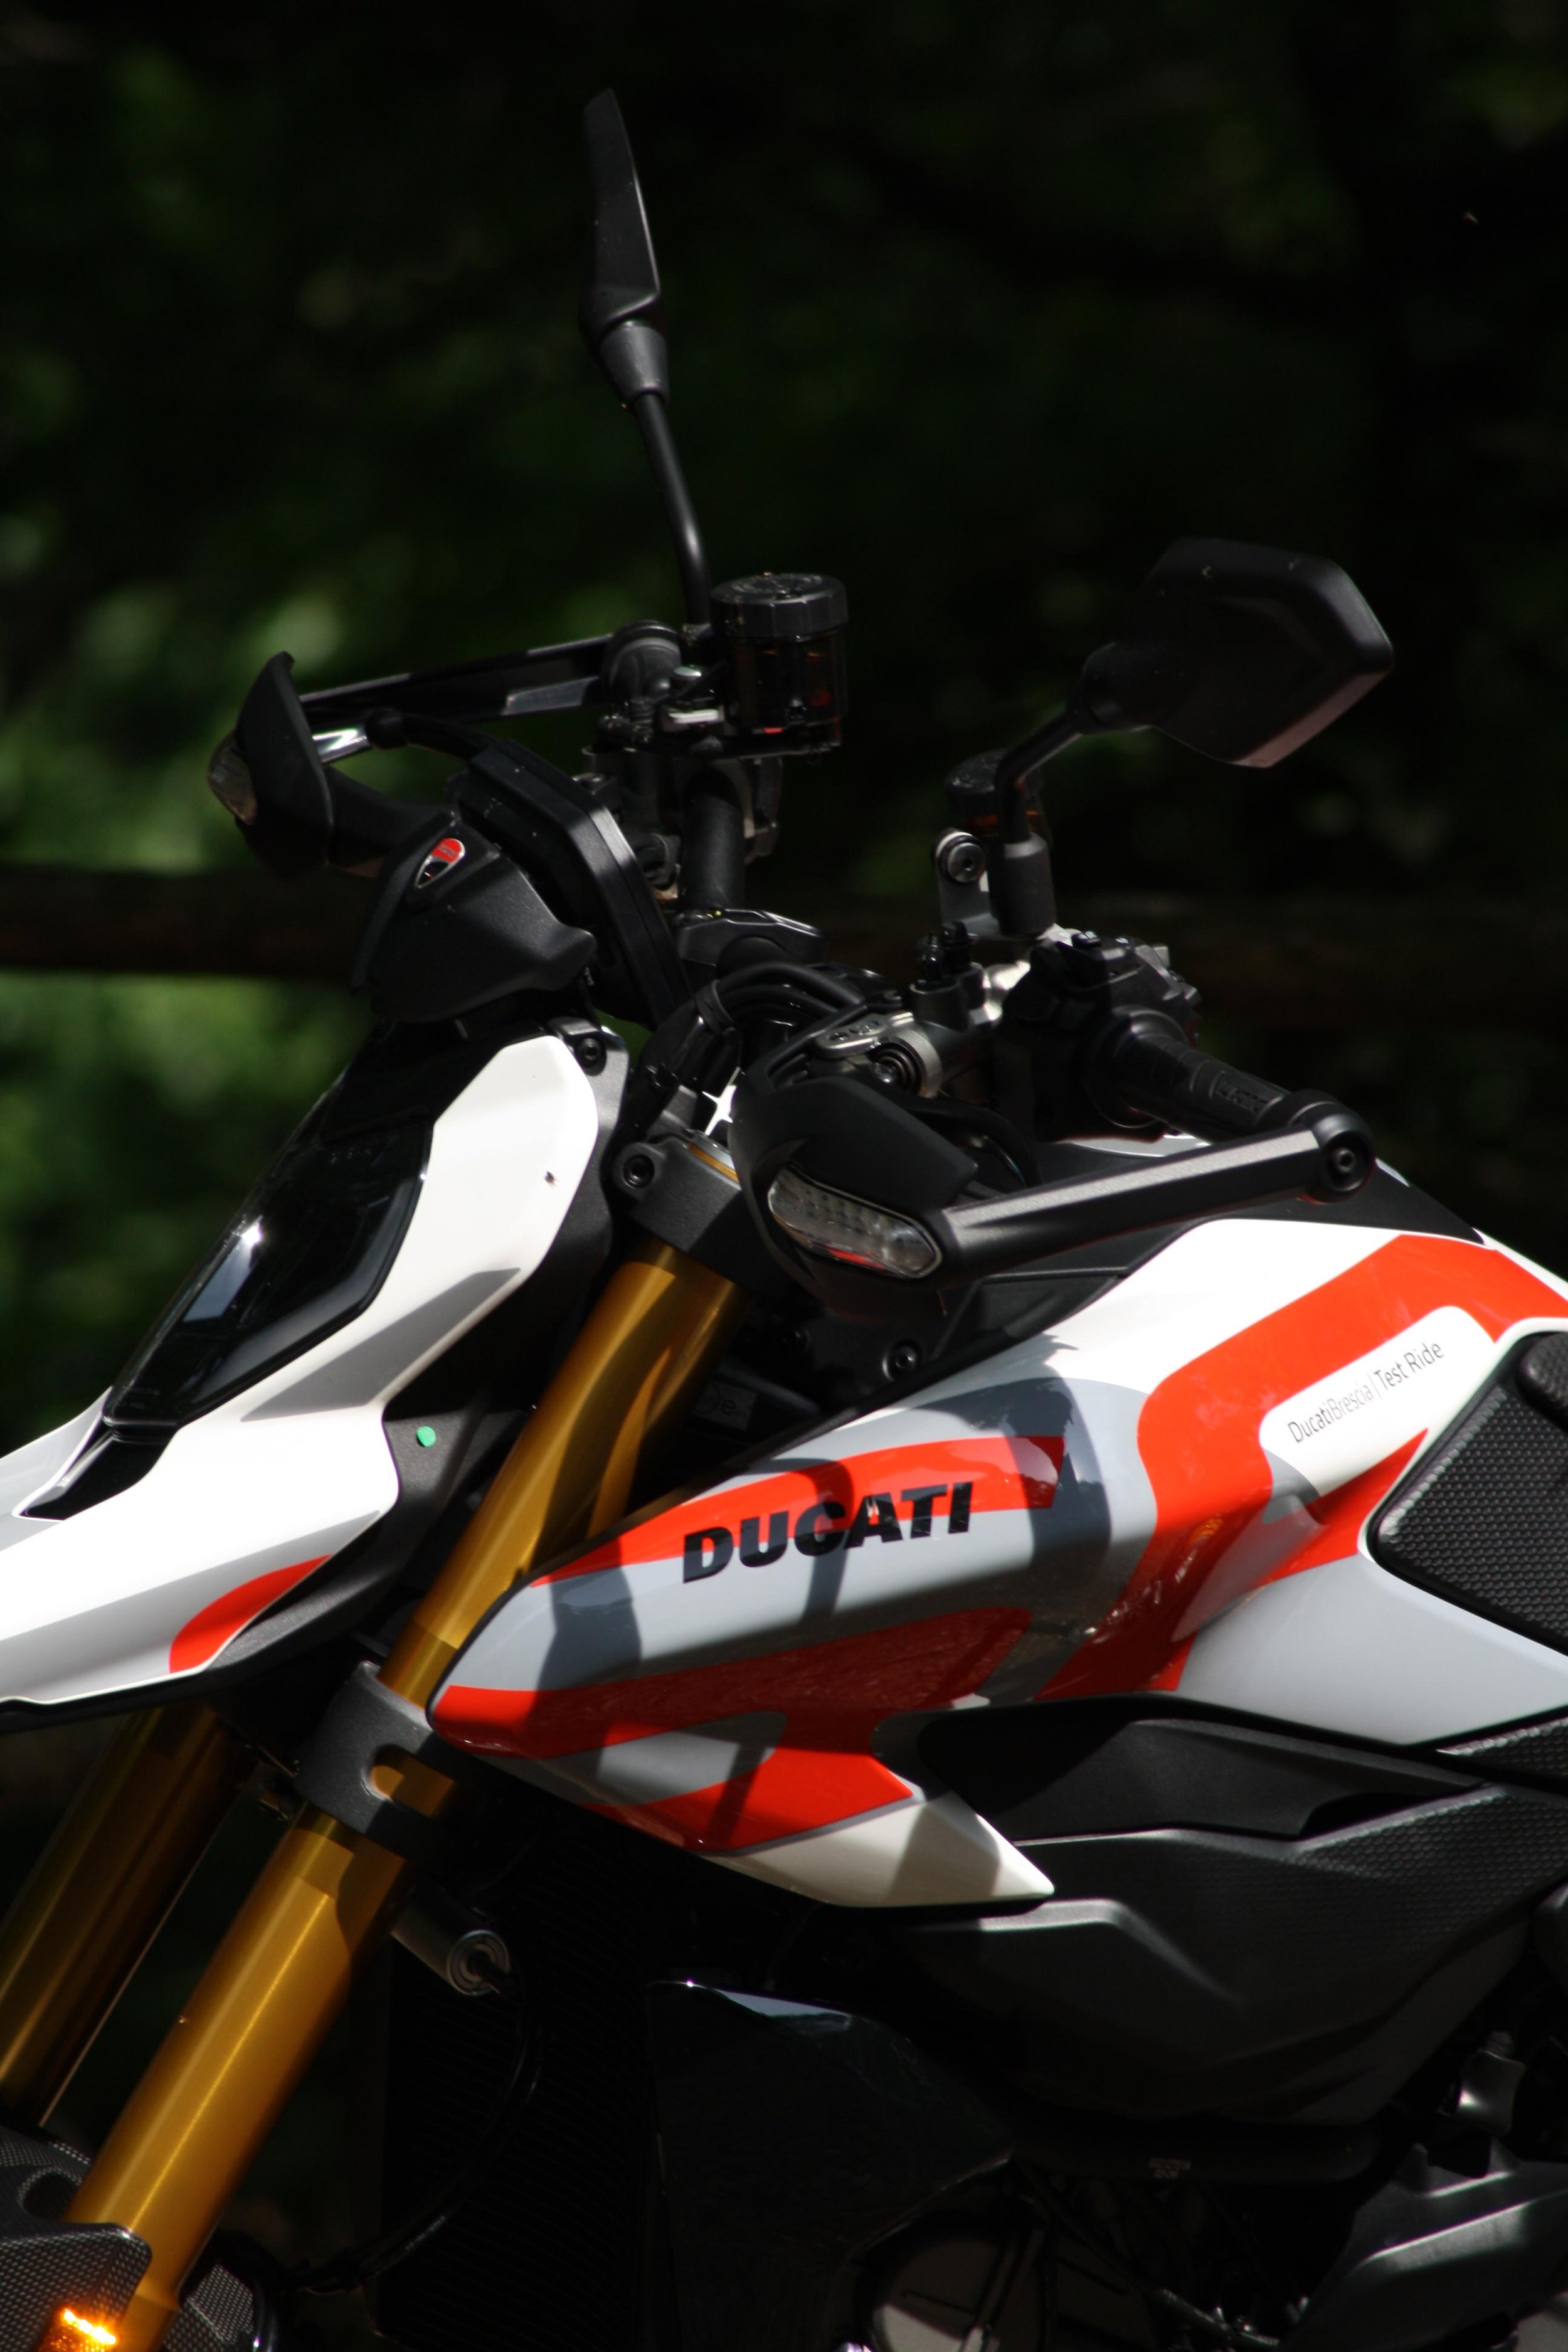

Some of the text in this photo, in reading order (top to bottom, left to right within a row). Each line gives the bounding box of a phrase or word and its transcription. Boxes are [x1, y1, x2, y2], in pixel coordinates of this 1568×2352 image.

[1374, 1362, 1409, 1391] Test
[1403, 1342, 1444, 1373] Ride
[683, 1481, 973, 1583] DUCATI
